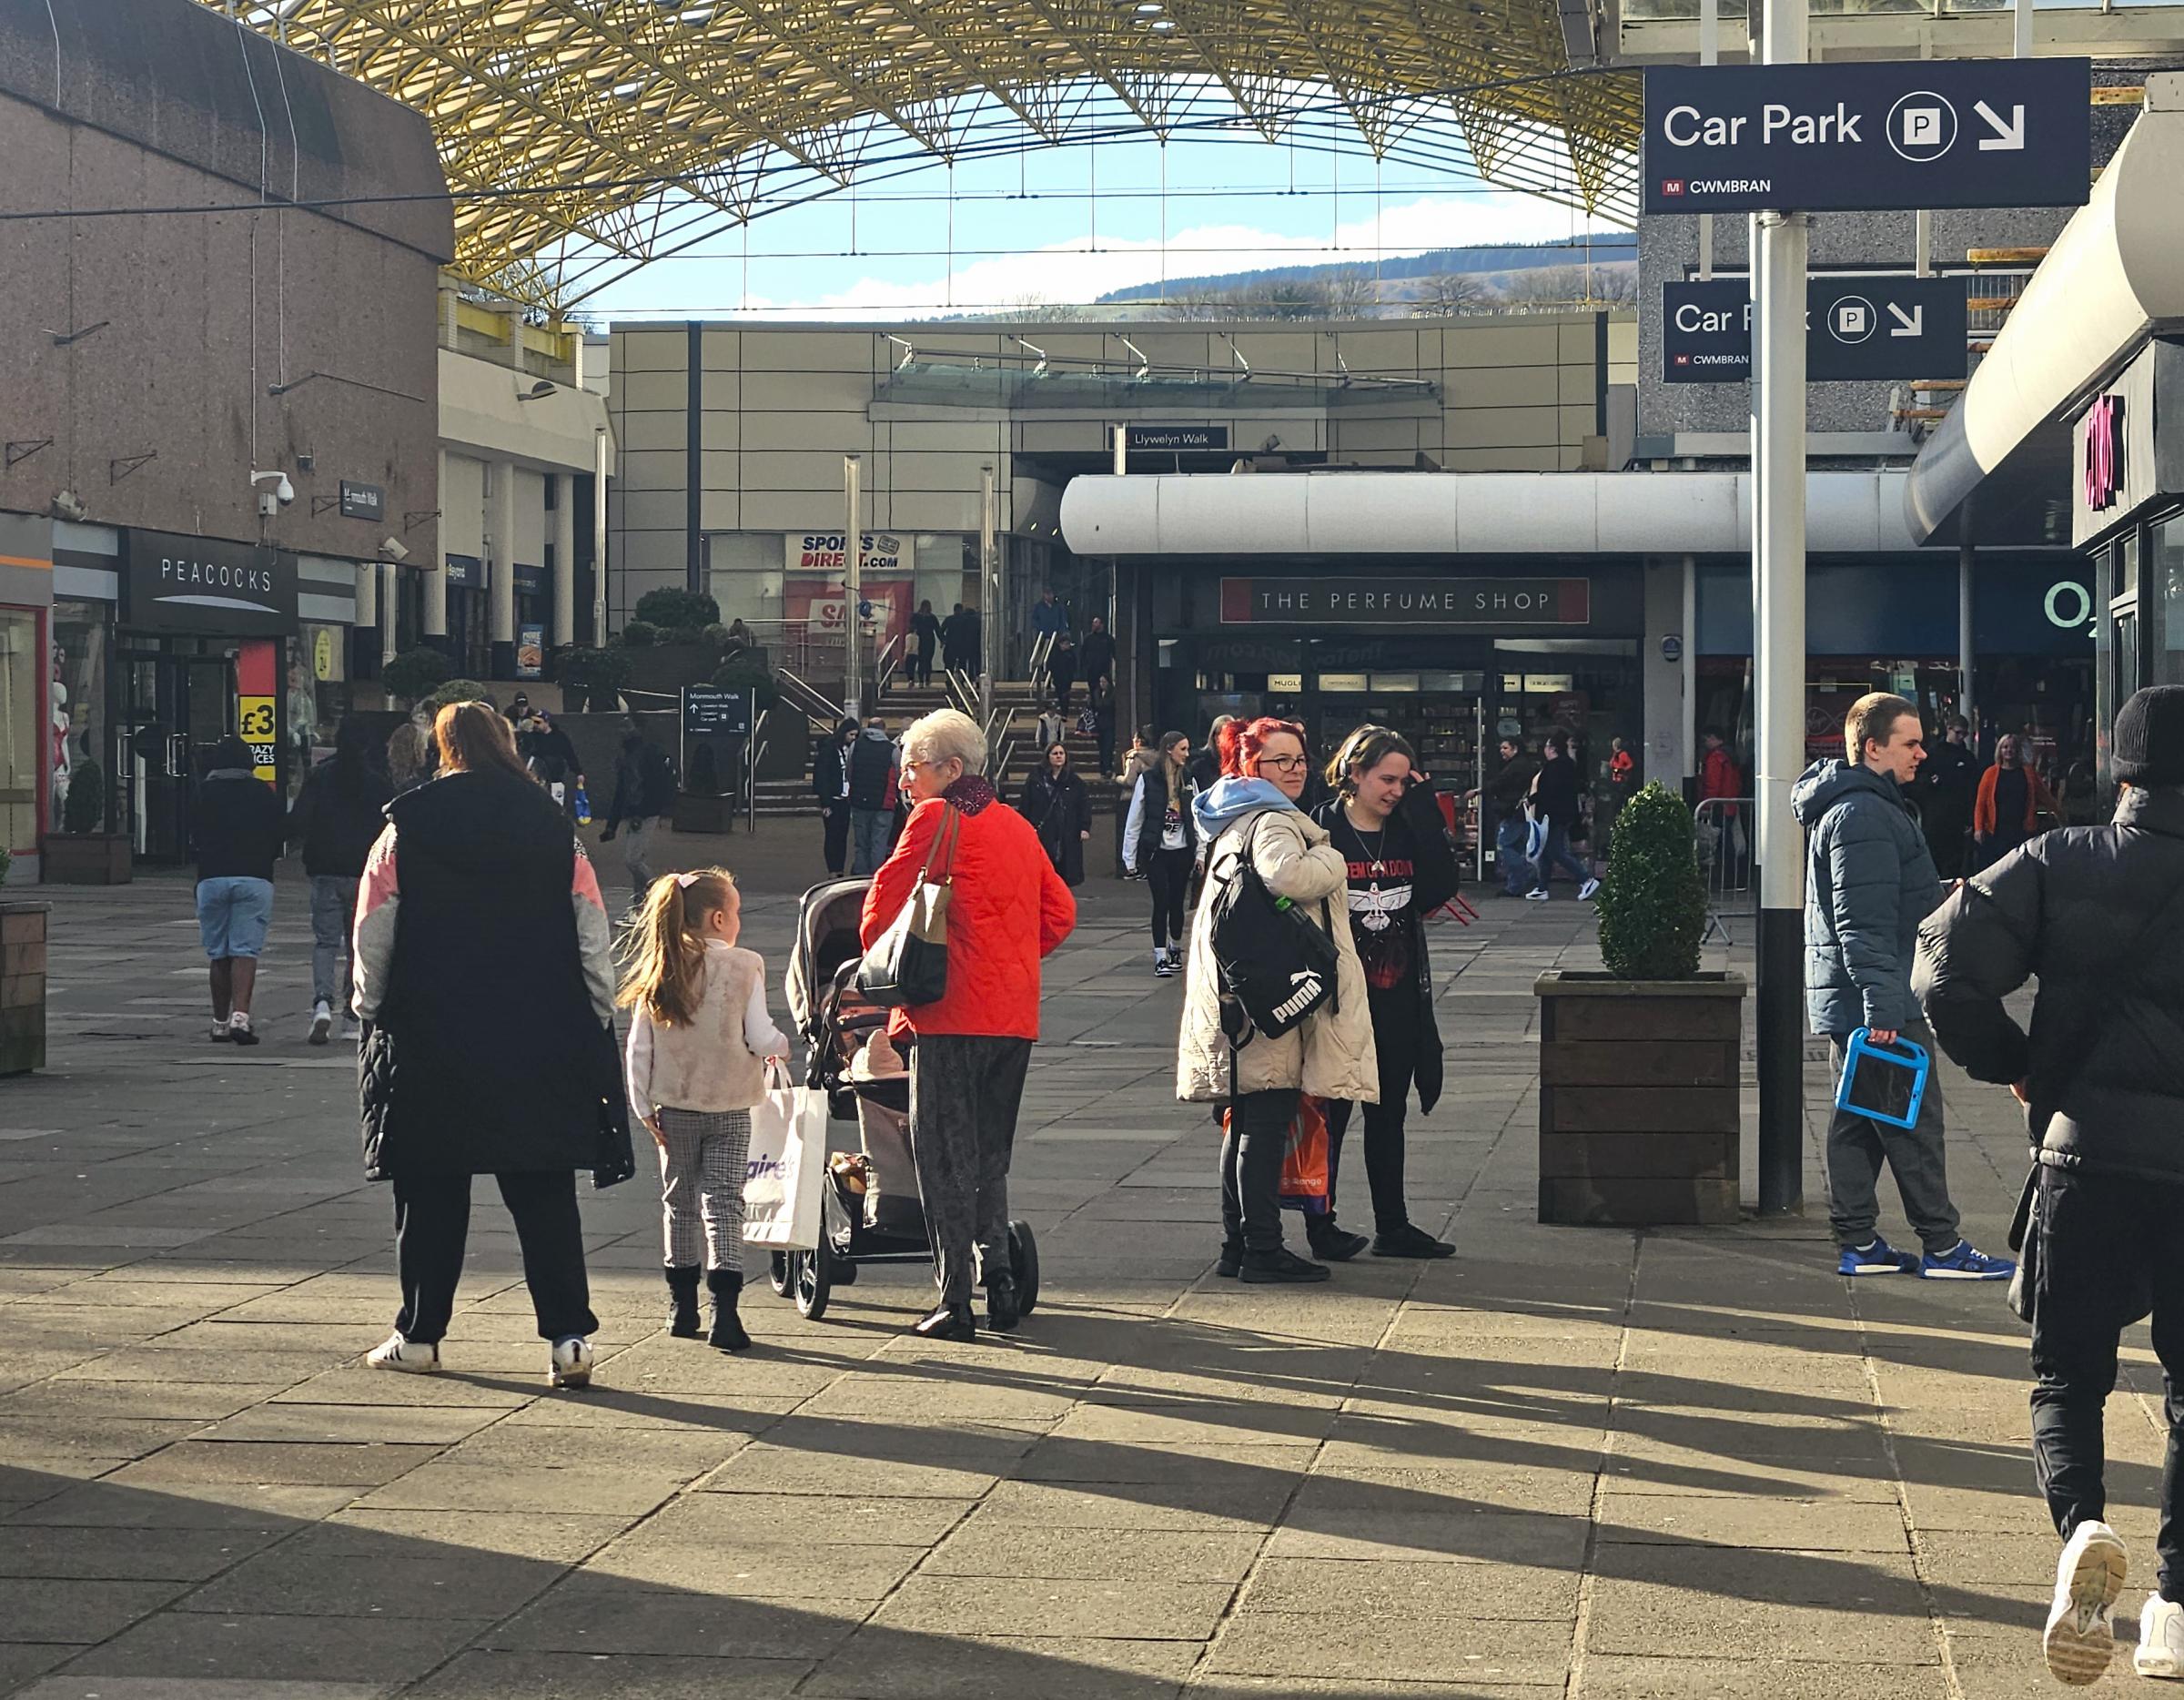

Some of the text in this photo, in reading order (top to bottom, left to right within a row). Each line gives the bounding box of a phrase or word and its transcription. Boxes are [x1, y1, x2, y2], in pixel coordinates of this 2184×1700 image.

[1663, 105, 1746, 147] Car
[1763, 102, 1863, 144] Park
[1690, 179, 1771, 194] CWMBRAN
[1674, 304, 1733, 332] Car
[1693, 355, 1749, 364] CWMBRAN
[1135, 433, 1208, 446] Llywelyn Walk
[802, 536, 875, 551] SPOS
[162, 558, 270, 592] PEACOCKS
[1262, 592, 1549, 609] THE PERFUME SHOP
[241, 704, 274, 735] £3
[249, 744, 275, 754] RAZY
[253, 754, 275, 764] ICES
[1271, 977, 1322, 1024] PUMA
[746, 1153, 794, 1180] aire's
